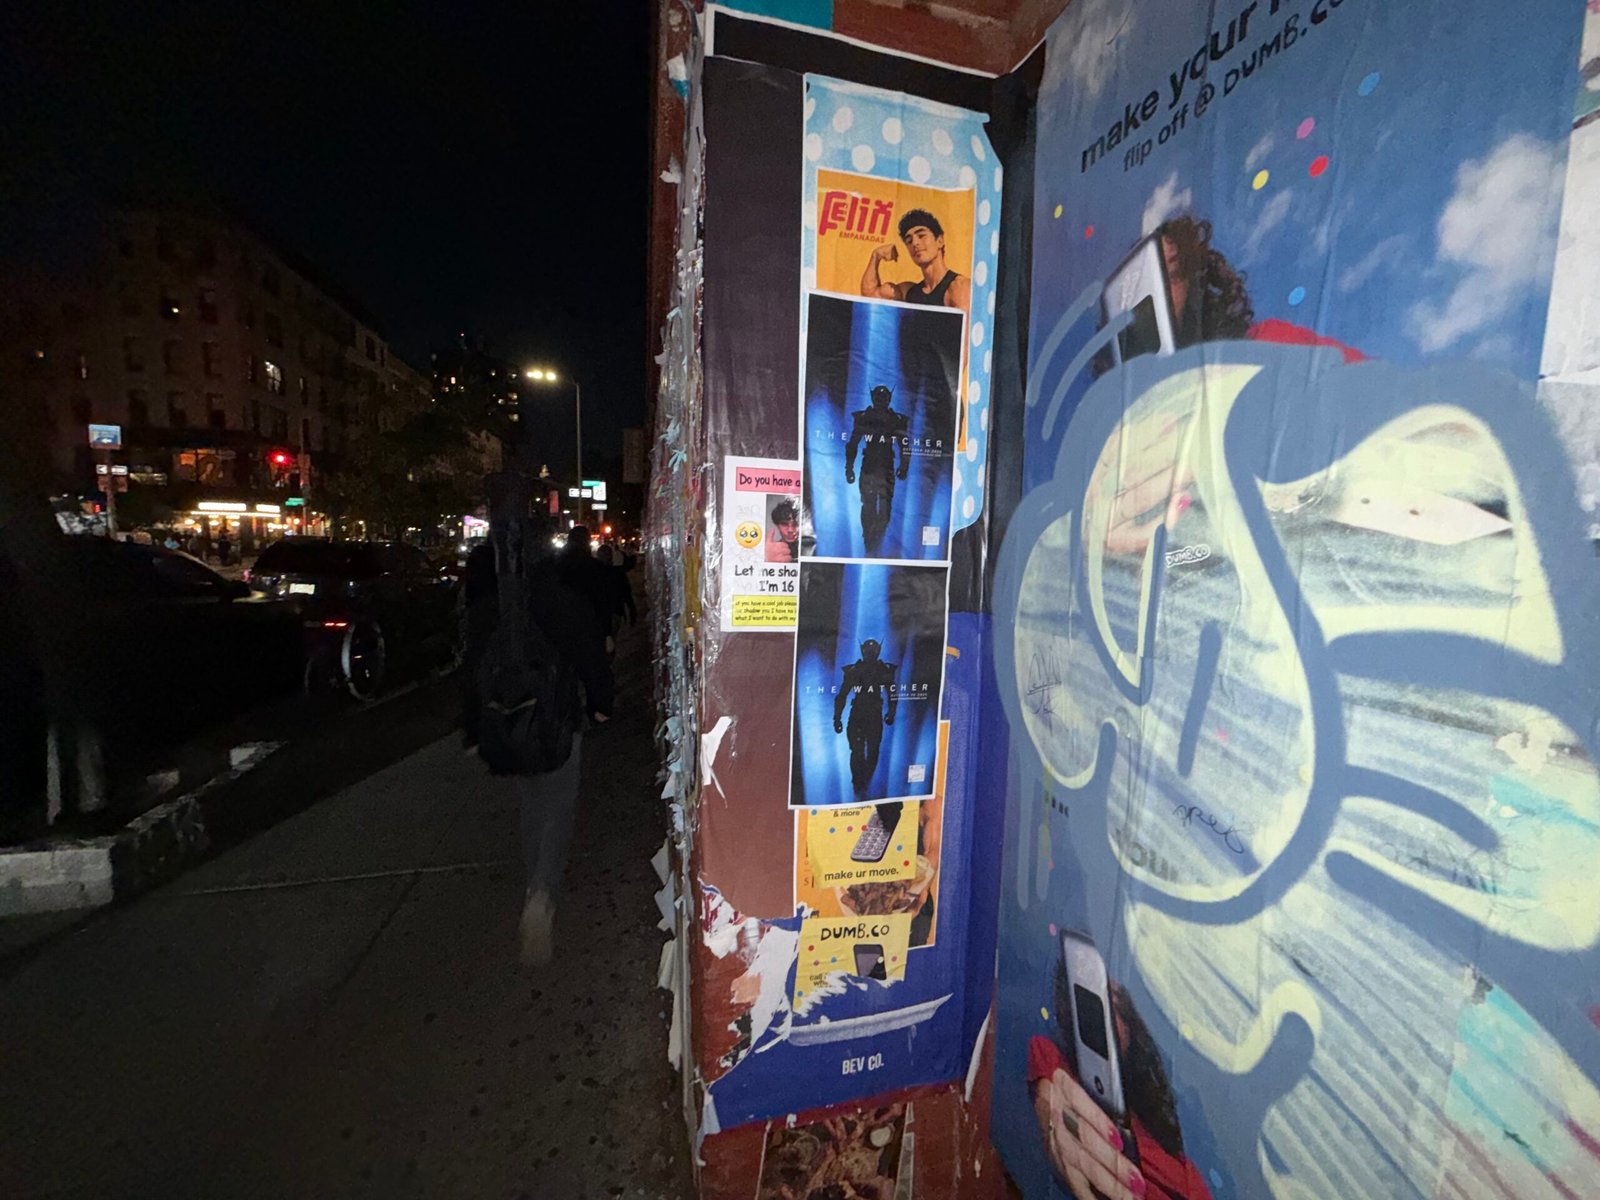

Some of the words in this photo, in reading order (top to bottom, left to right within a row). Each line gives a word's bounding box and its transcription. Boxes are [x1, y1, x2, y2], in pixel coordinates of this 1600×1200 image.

[1081, 90, 1159, 173] make
[1168, 1, 1257, 110] your
[1123, 139, 1153, 172] flip
[1158, 102, 1189, 145] off
[838, 231, 886, 243] EMPANADAS
[814, 430, 848, 441] THE
[864, 434, 943, 448] WATCHER
[739, 472, 753, 486] Do
[755, 476, 770, 489] you
[772, 473, 793, 487] have
[734, 564, 754, 577] Let
[759, 580, 779, 593] I'm
[781, 580, 795, 593] 16
[805, 686, 837, 694] THE
[854, 683, 929, 693] WATCHER
[840, 809, 861, 817] more
[824, 868, 853, 881] make
[856, 867, 867, 878] ur
[869, 867, 900, 878] move.
[820, 922, 890, 941] DUMB.CO
[842, 1056, 865, 1076] BEV
[868, 1053, 885, 1072] CO.
